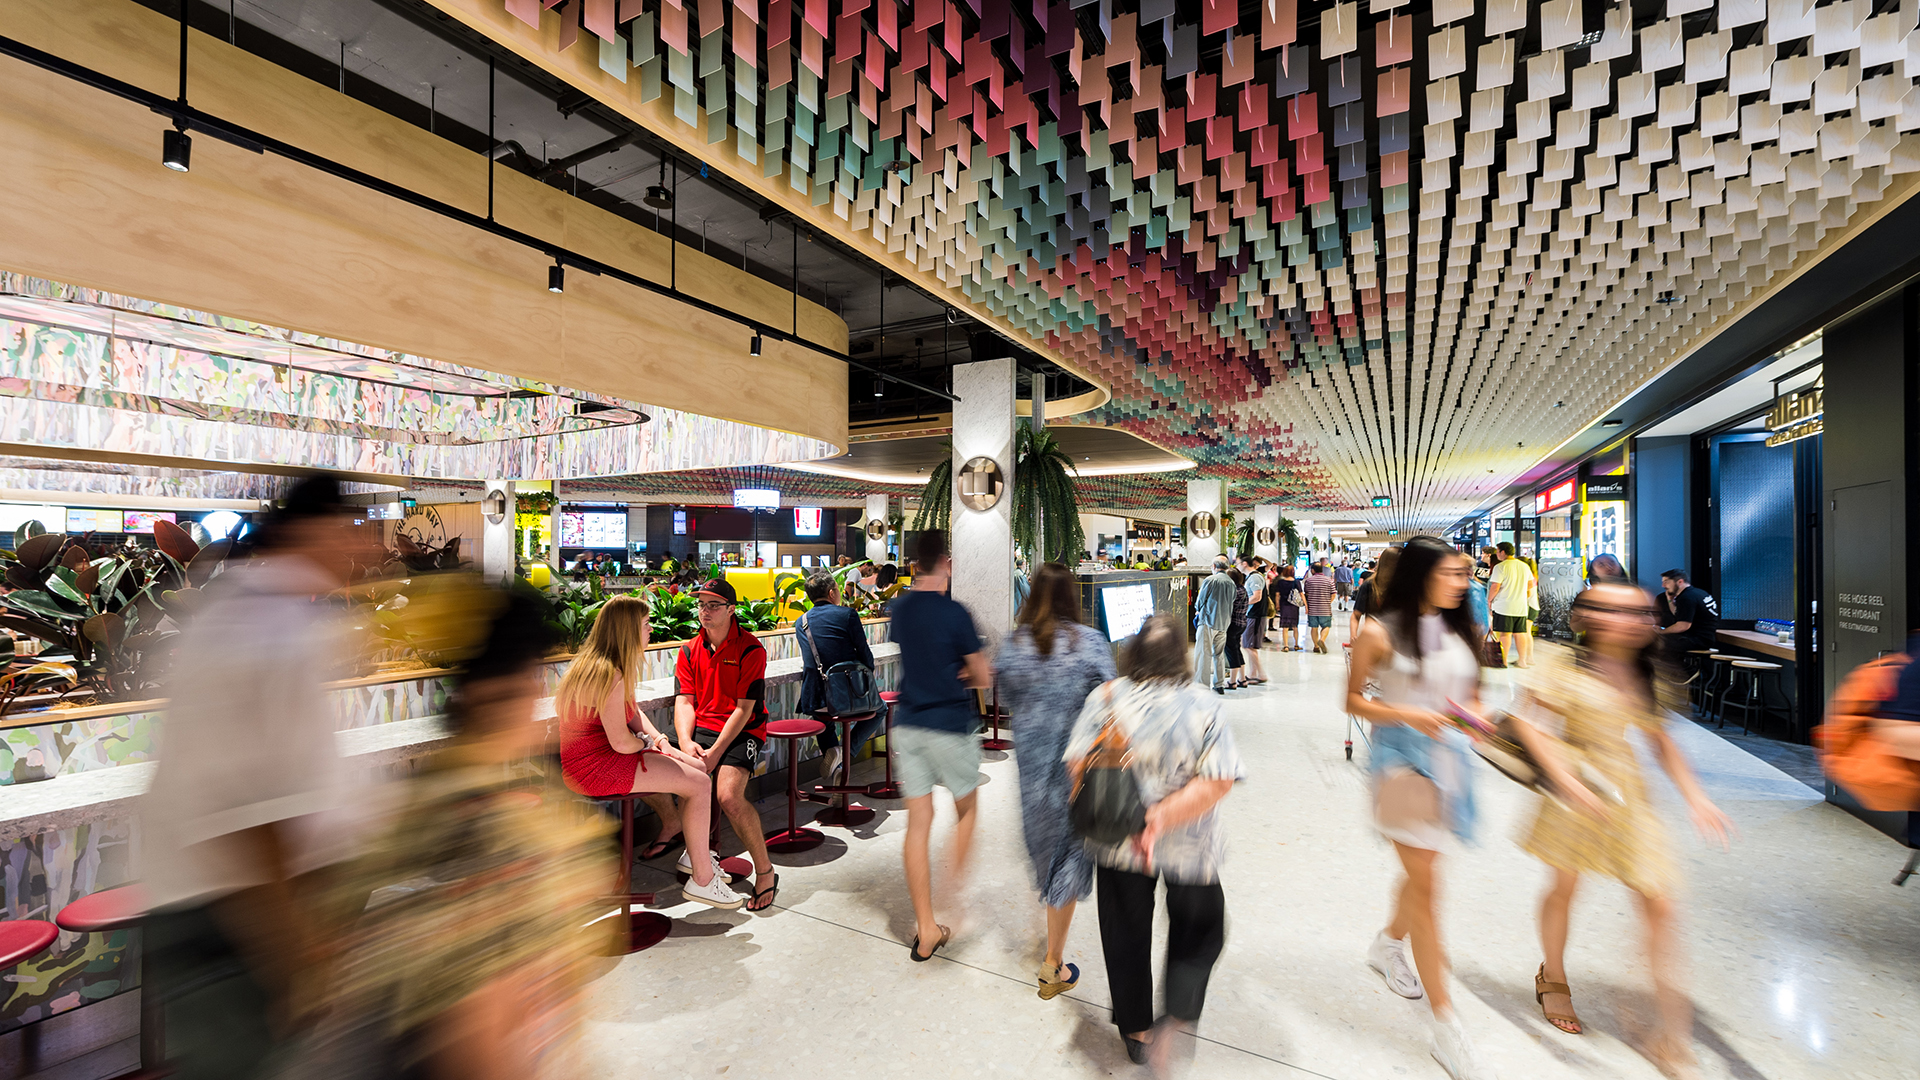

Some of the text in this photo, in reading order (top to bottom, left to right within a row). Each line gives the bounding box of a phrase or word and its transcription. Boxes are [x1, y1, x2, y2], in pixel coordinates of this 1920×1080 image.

[395, 518, 406, 536] THE
[426, 507, 439, 528] WAY
[1838, 593, 1885, 606] FIRE HOSE REEL
[1838, 607, 1881, 620] FIRE HYDRANT
[1838, 621, 1879, 633] FIRE EXTINGUISHER
